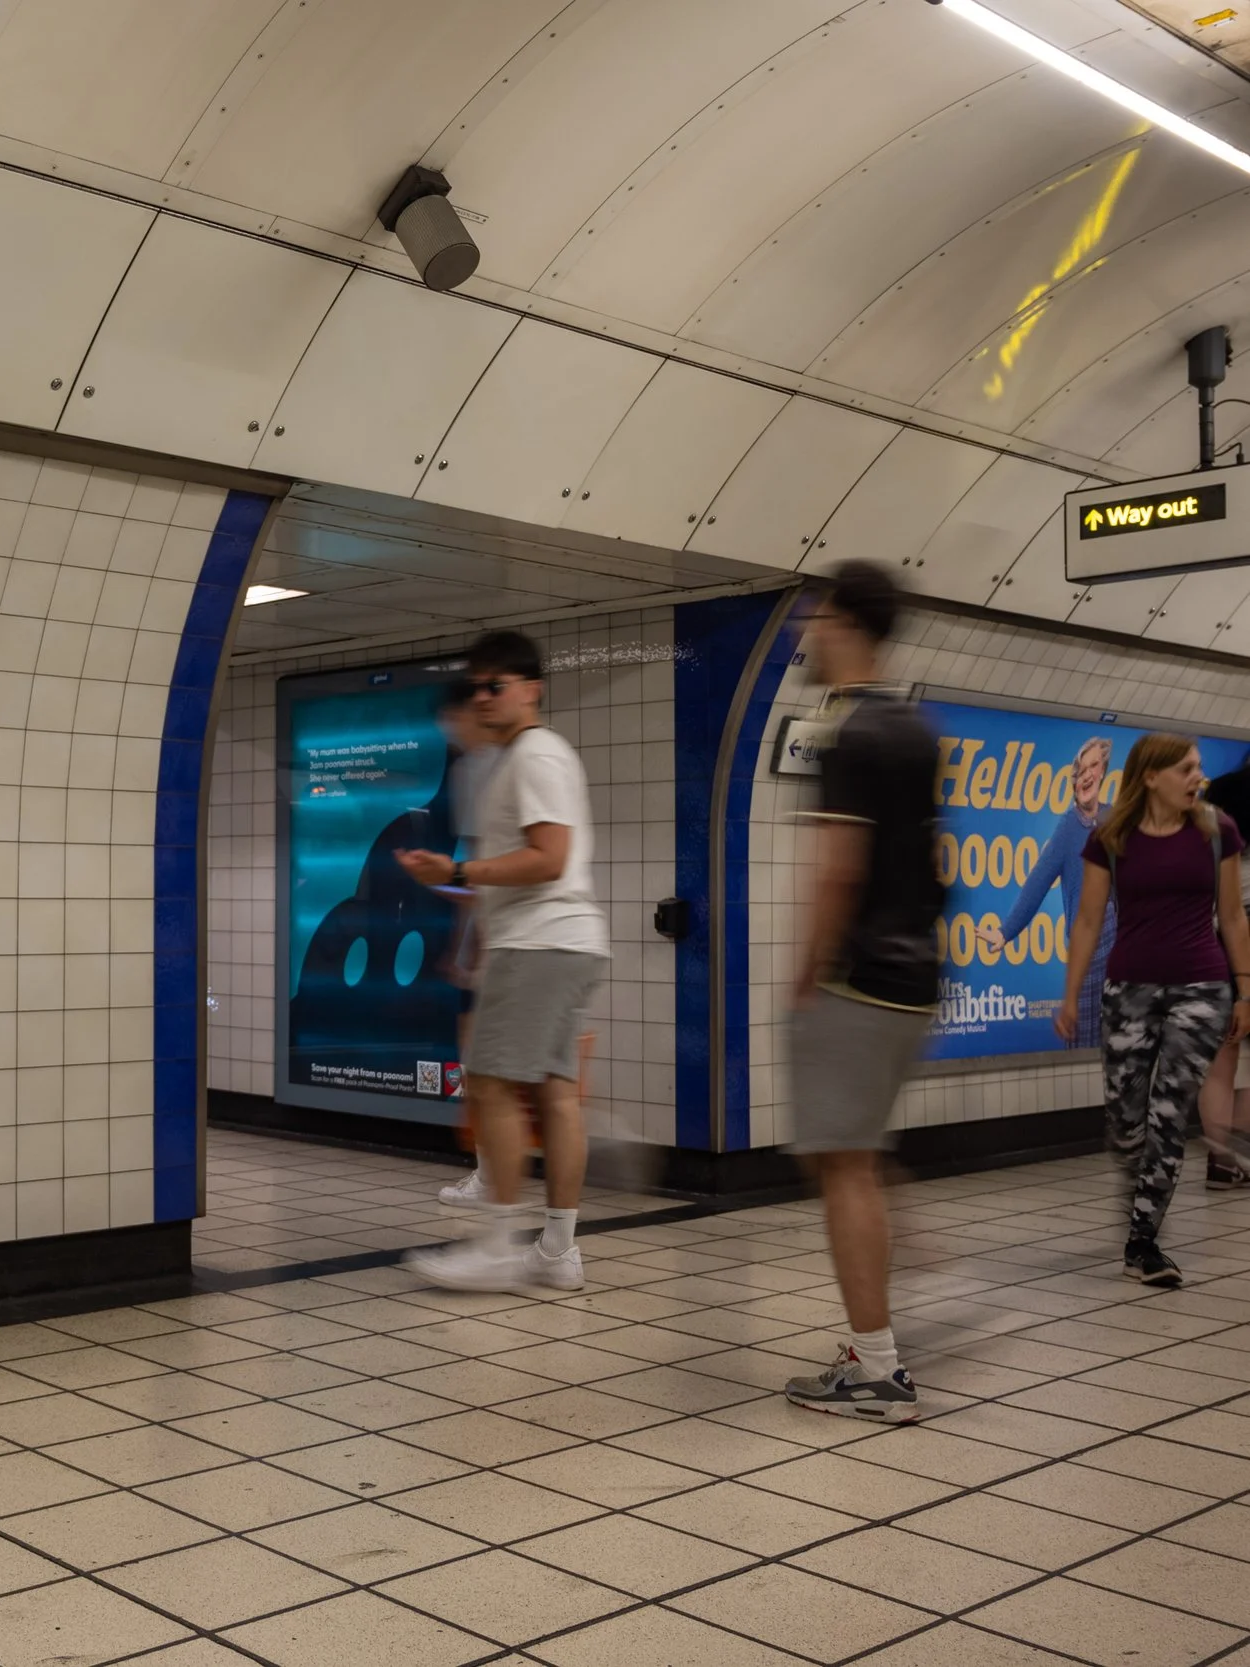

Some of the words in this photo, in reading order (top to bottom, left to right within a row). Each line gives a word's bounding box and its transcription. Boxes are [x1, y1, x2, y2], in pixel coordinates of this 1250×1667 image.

[1105, 504, 1154, 526] Way
[1157, 496, 1198, 518] out
[350, 744, 387, 755] babysitting
[387, 741, 406, 751] when
[407, 741, 419, 749] the
[324, 759, 354, 770] poonami
[310, 774, 322, 782] She
[341, 771, 365, 780] offered
[931, 984, 1026, 1025] oubtfire
[944, 1025, 966, 1035] Comedy
[966, 1023, 987, 1034] Musical
[311, 1063, 327, 1073] Save
[327, 1066, 342, 1075] your
[342, 1066, 359, 1078] night
[360, 1068, 376, 1077] from
[383, 1072, 414, 1081] poonami
